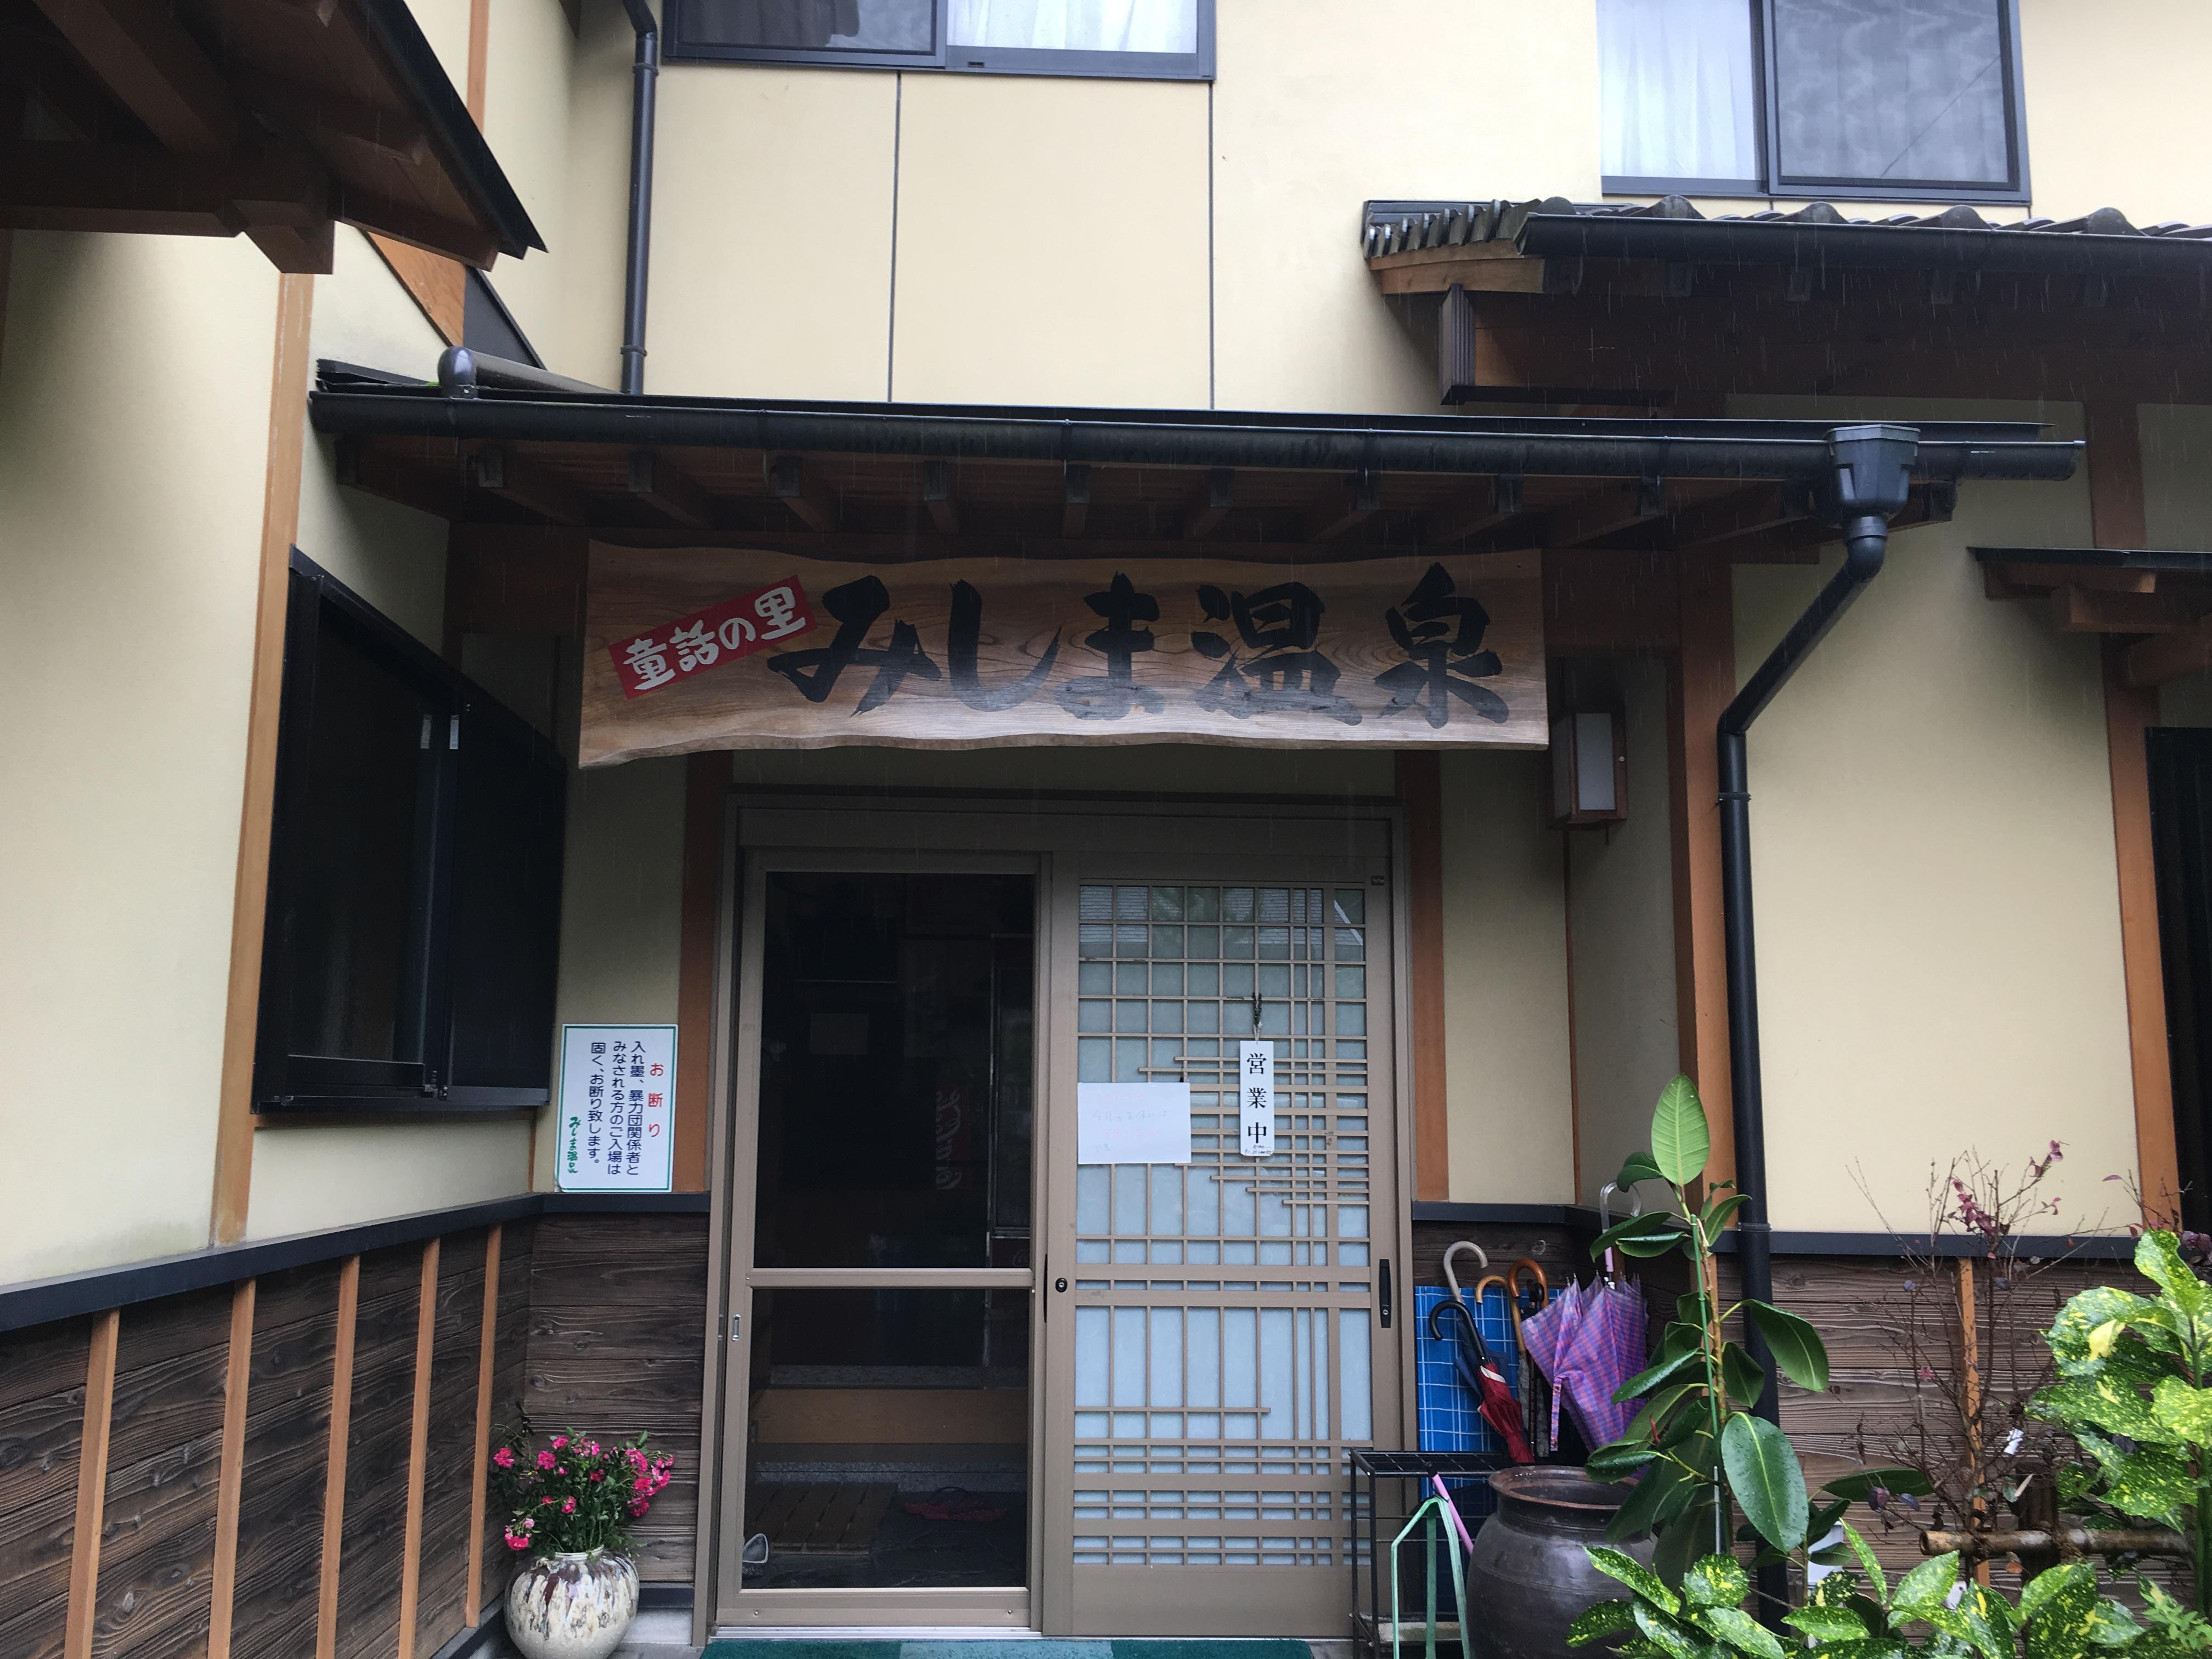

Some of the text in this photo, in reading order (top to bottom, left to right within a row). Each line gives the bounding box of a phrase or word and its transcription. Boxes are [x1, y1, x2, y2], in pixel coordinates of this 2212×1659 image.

[623, 586, 806, 691] 童話の里
[768, 561, 1510, 729] みしま温泉
[587, 1042, 606, 1164] 固く、お断り致します。
[607, 1041, 627, 1175] みなされる方のご入場は
[626, 1041, 646, 1176] 入れ墨、暴力団関係者と
[647, 1063, 664, 1138] お断り
[1246, 1052, 1268, 1144] 営業中
